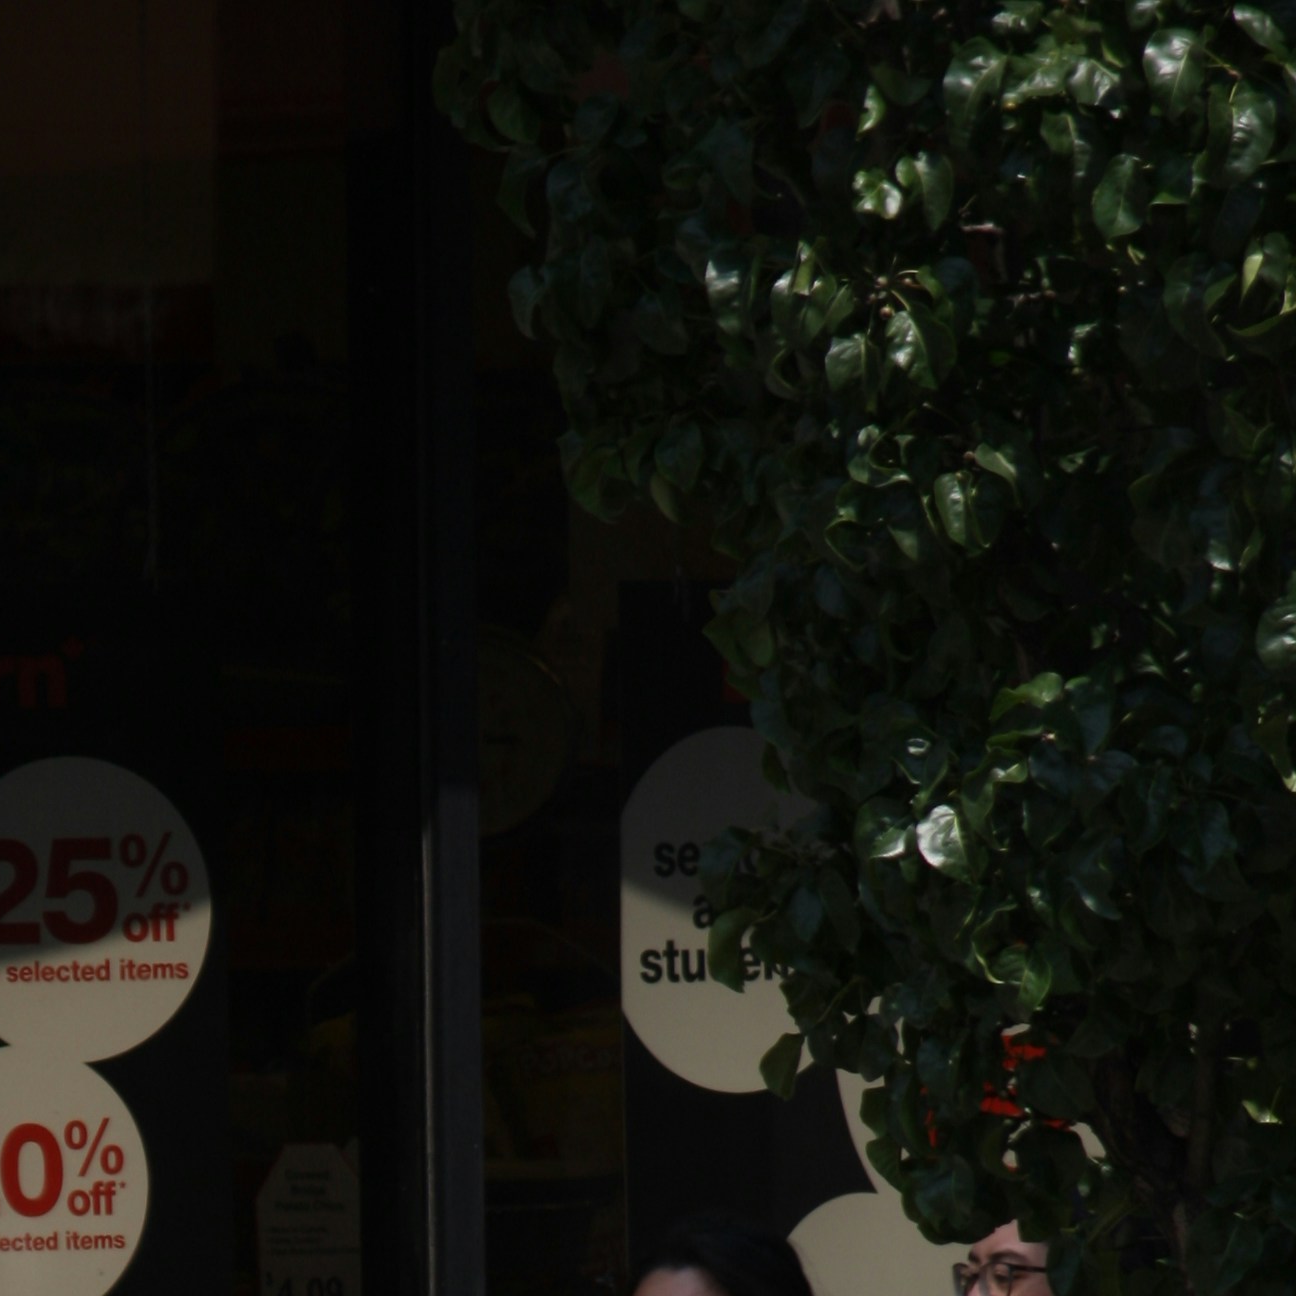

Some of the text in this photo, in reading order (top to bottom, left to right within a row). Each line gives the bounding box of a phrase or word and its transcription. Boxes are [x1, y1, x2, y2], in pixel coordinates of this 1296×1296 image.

[7, 959, 111, 982] selected
[119, 959, 189, 981] items
[65, 1231, 125, 1251] items
